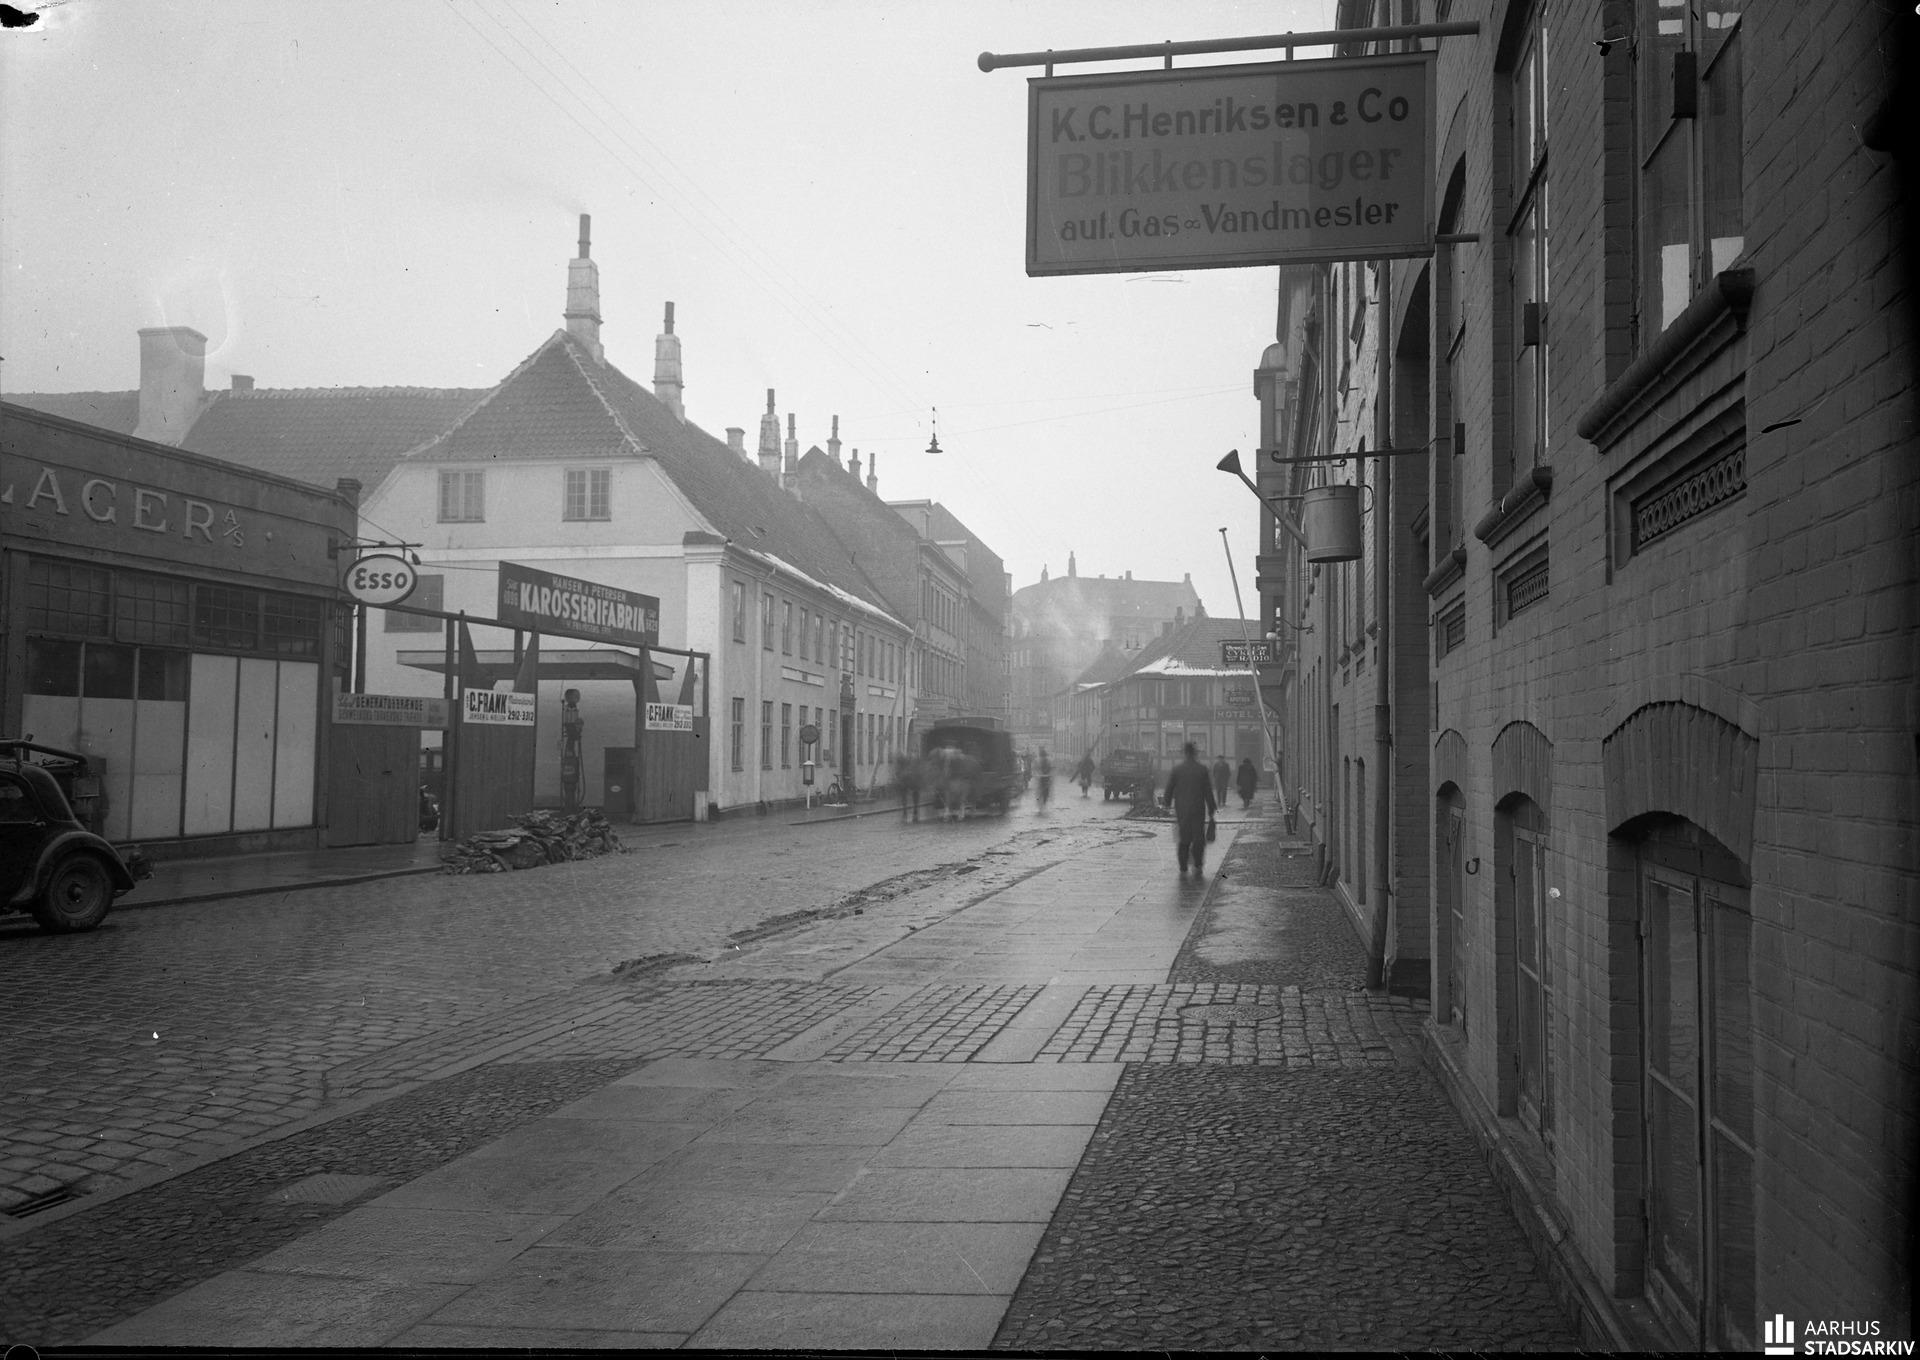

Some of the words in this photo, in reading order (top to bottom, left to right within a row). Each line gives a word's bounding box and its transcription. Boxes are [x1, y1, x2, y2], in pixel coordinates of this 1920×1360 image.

[1329, 100, 1348, 125] &
[1357, 88, 1410, 123] Co
[1058, 141, 1401, 198] Blikkenslager
[520, 582, 645, 633] KAROSSERIFABRIK
